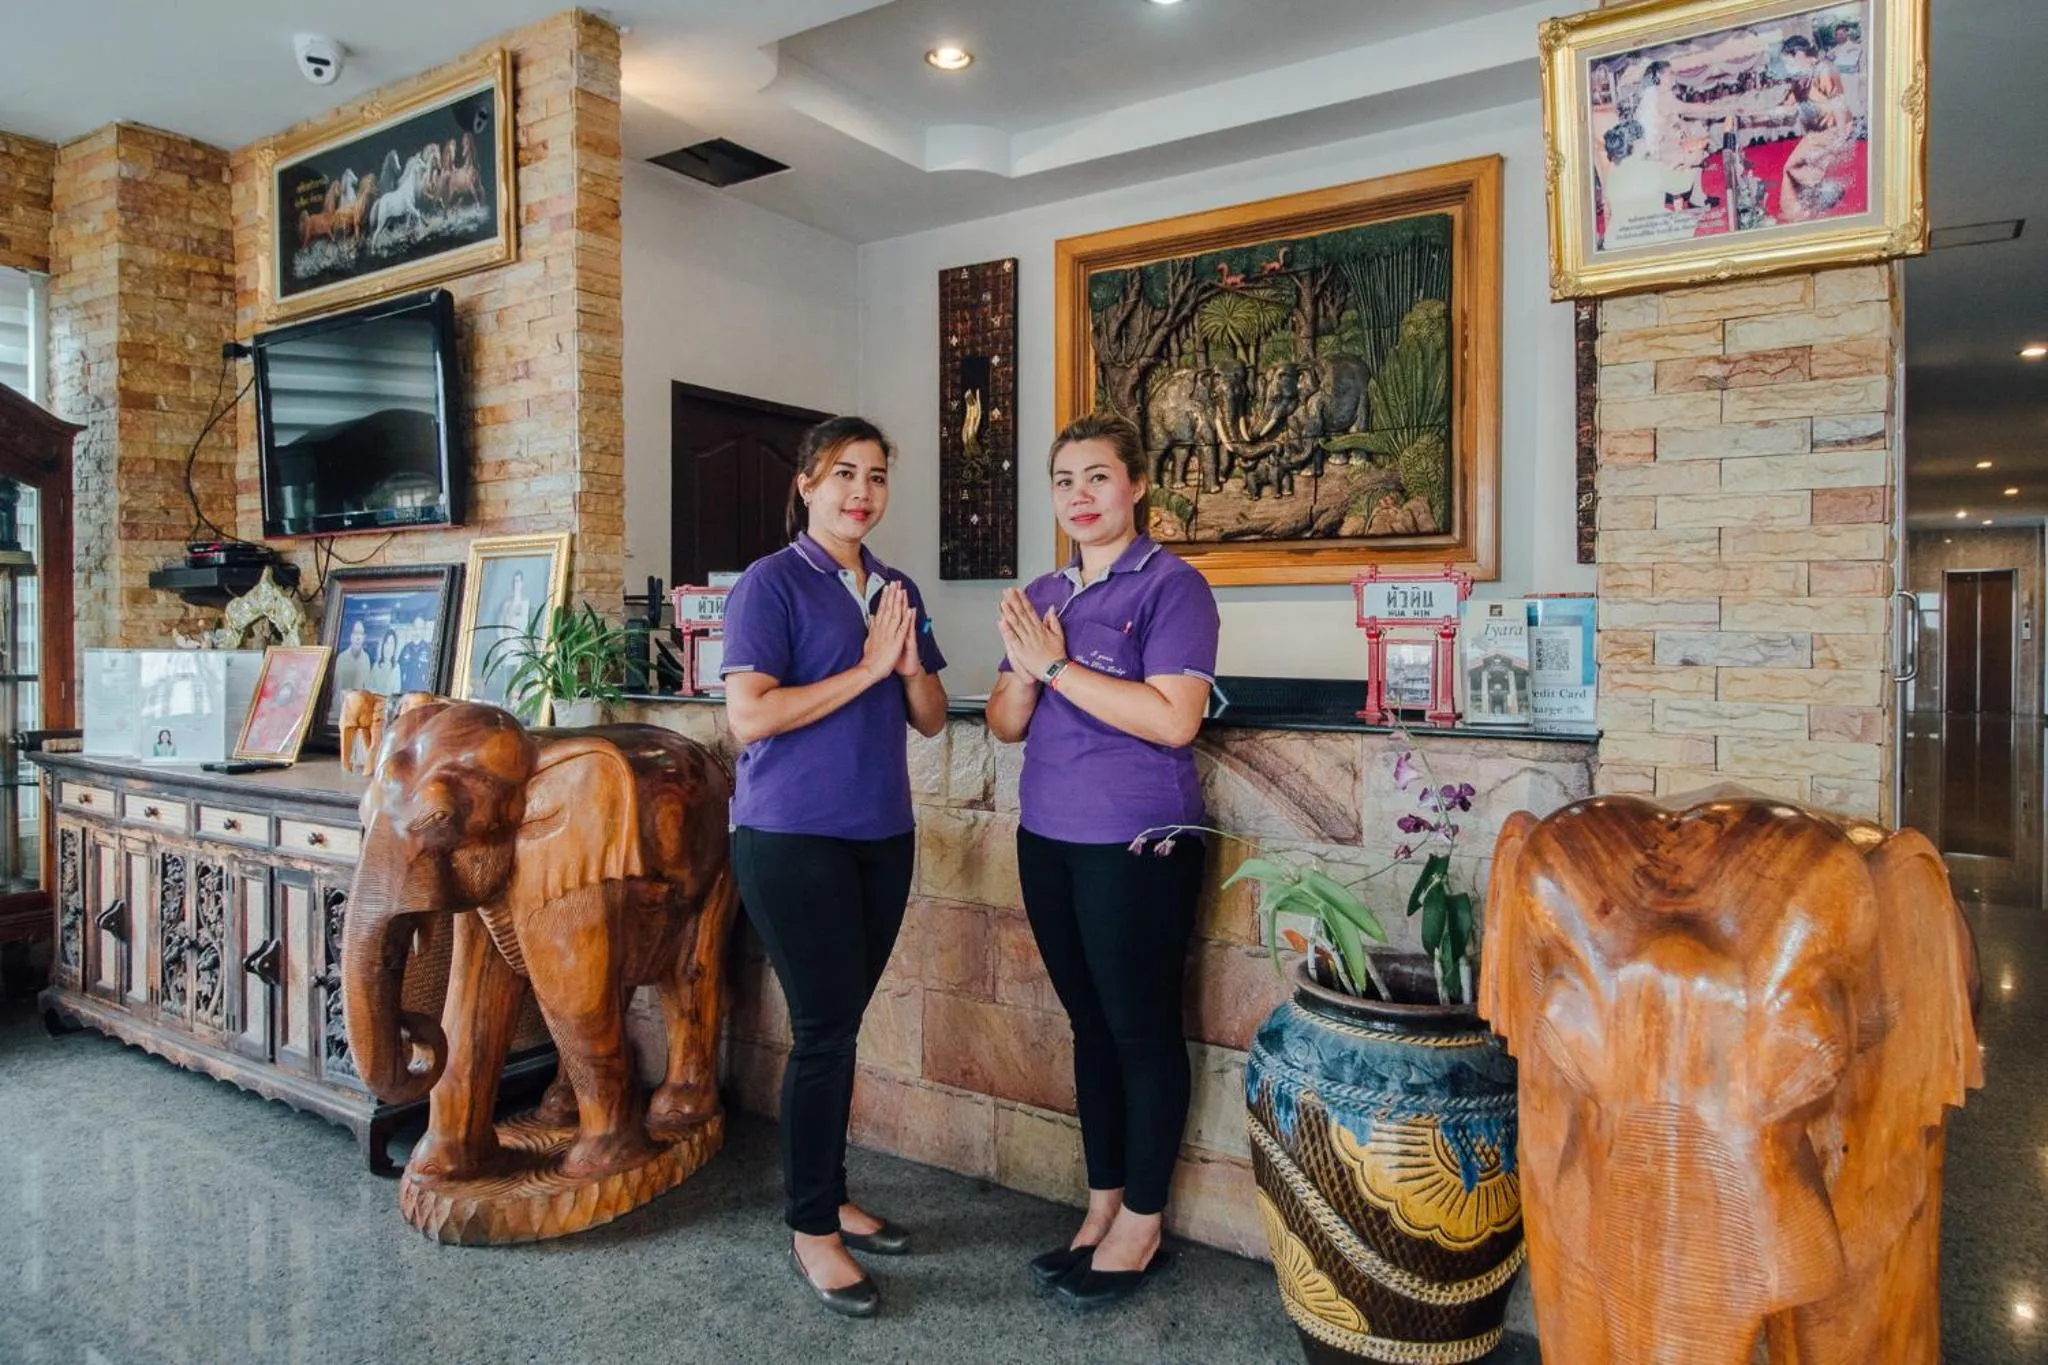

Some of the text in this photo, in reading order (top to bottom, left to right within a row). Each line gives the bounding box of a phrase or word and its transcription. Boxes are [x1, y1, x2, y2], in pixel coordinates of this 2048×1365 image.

[1387, 585, 1434, 608] หัวหิน
[698, 596, 724, 613] หัวหิ
[1387, 609, 1430, 617] HUA HIN
[1532, 687, 1586, 698] edit Card
